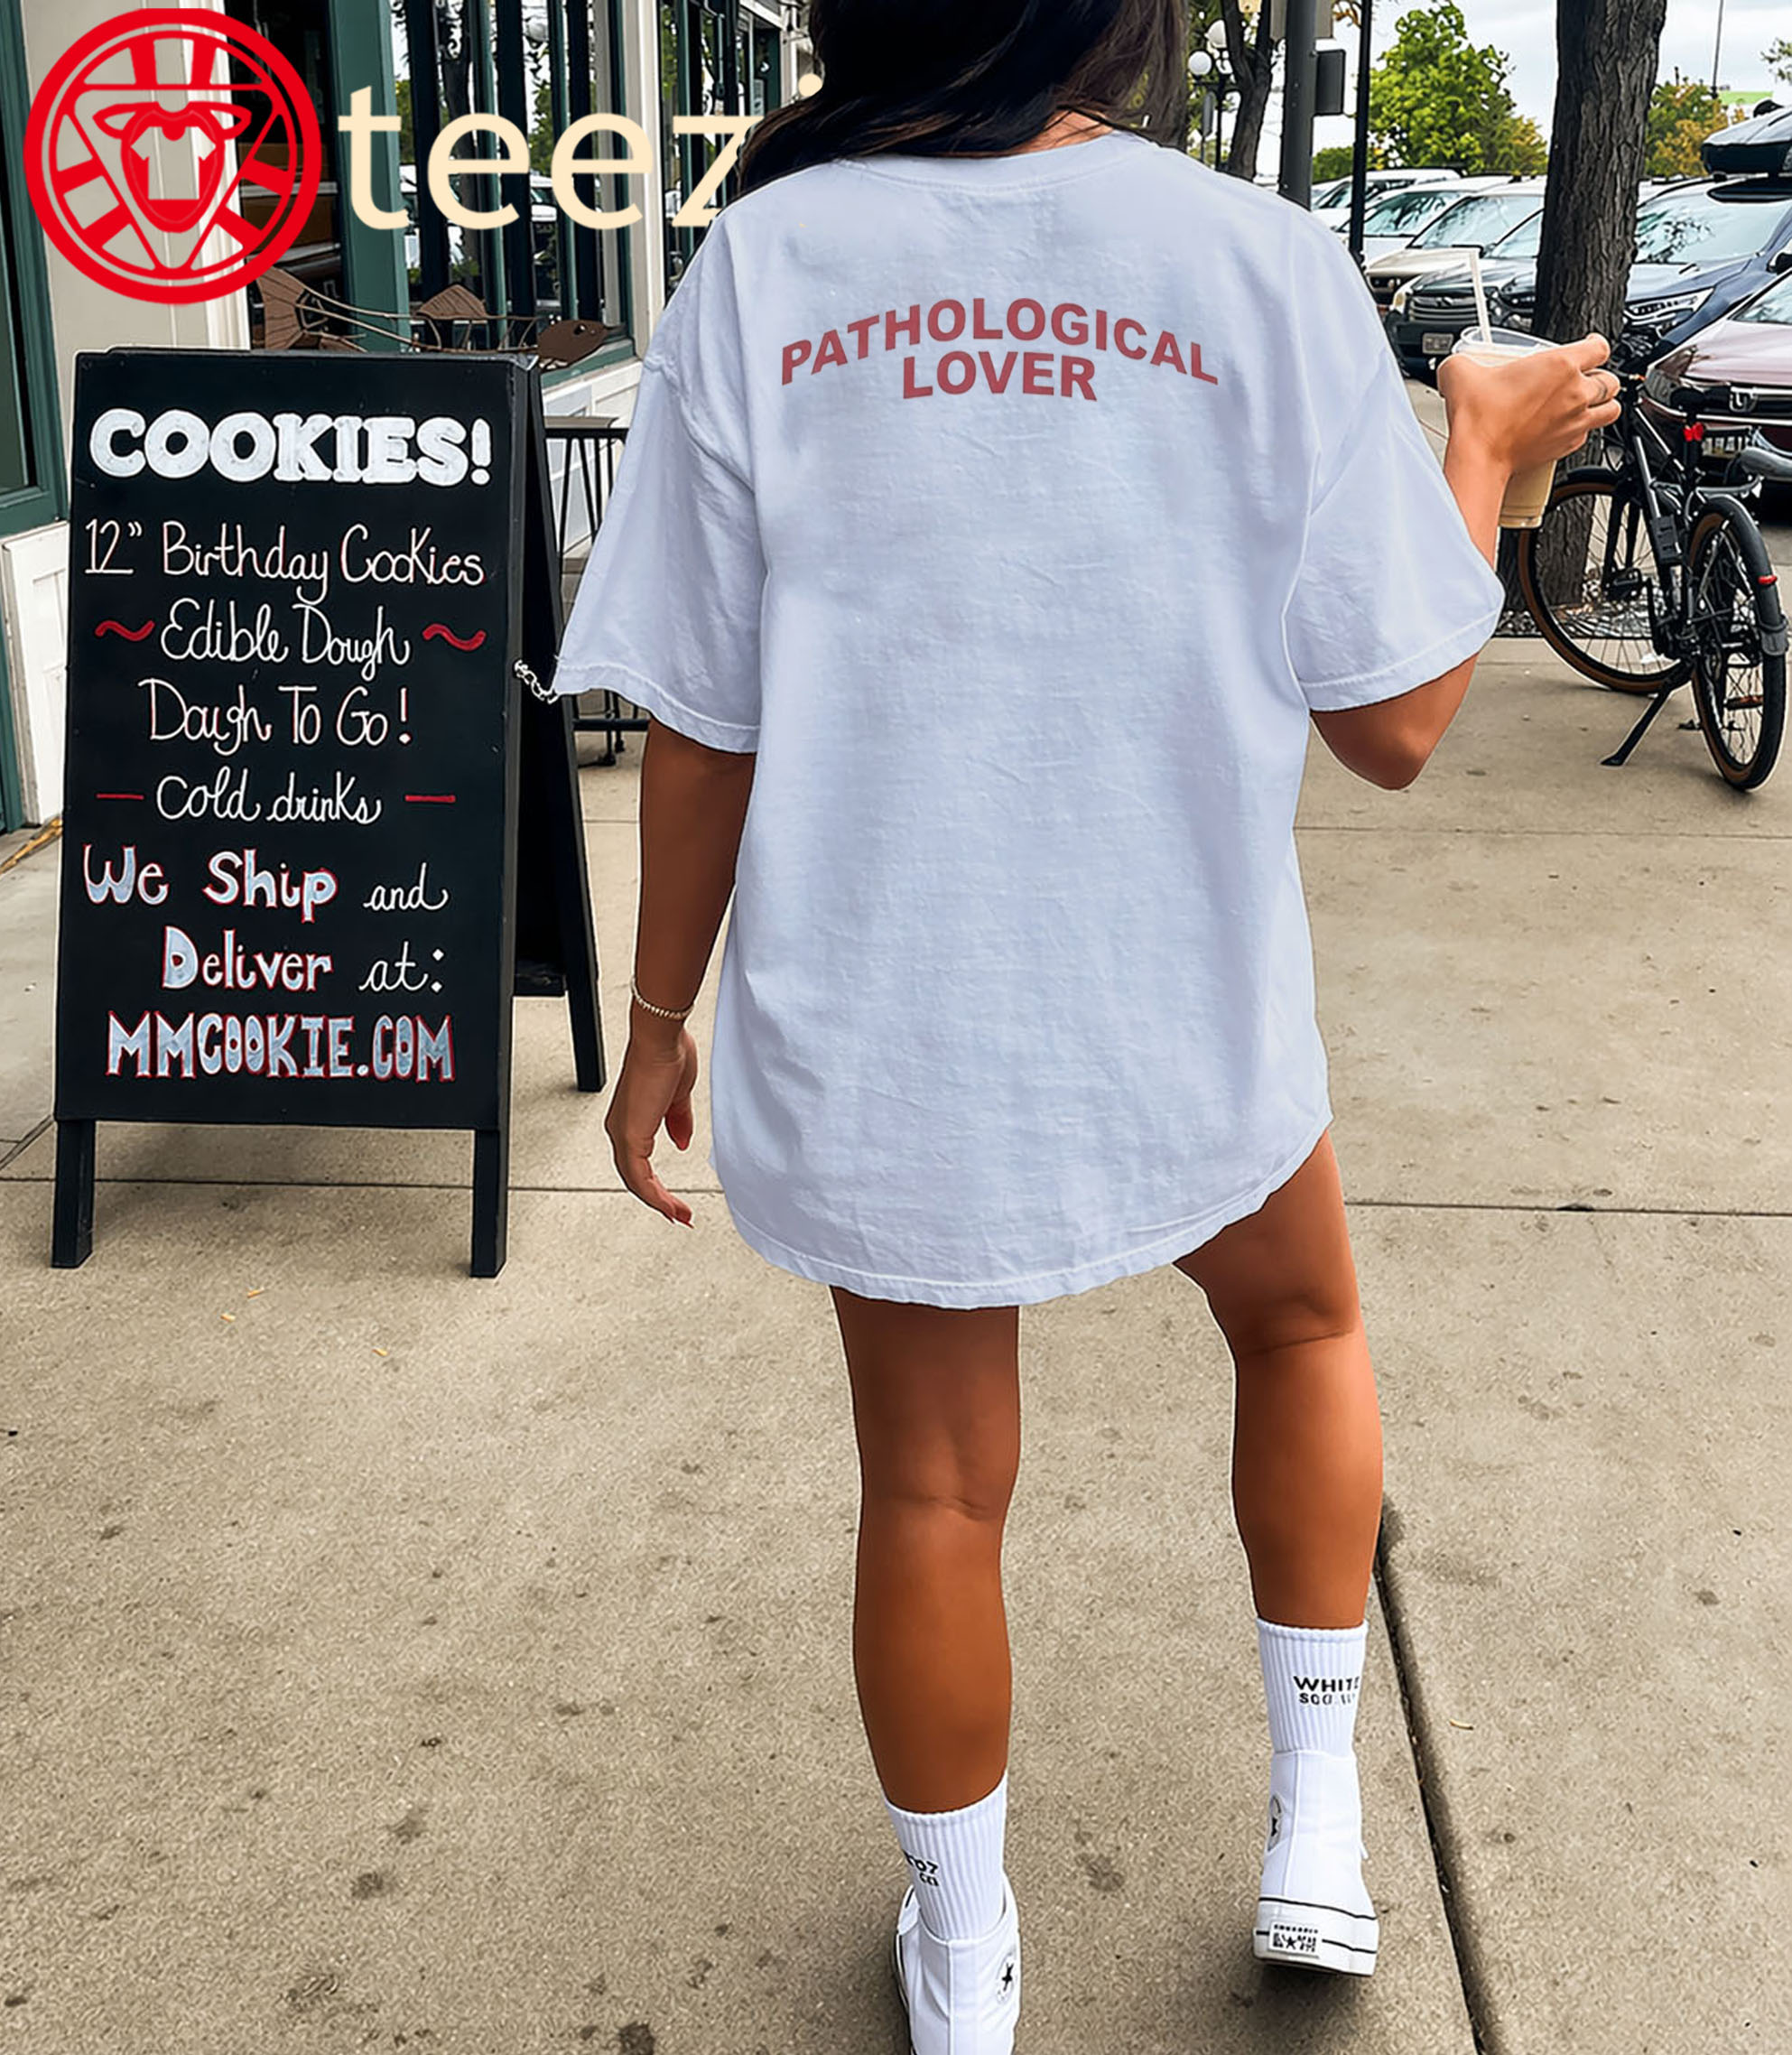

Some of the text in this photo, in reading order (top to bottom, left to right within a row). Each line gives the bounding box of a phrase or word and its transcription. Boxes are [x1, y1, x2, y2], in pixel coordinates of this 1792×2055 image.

[782, 298, 1219, 386] PATHOLOGICAL
[903, 350, 1097, 402] LOVER
[89, 408, 492, 487] COOKIES!
[162, 520, 329, 605] Birthday
[160, 597, 411, 682] Edible Dough
[137, 677, 273, 757] Dough
[278, 685, 321, 745] To
[156, 765, 262, 822] Cold
[83, 843, 450, 924] We Ship and
[162, 925, 334, 991] Deliver
[105, 1009, 455, 1083] MMCOOKIE.COM
